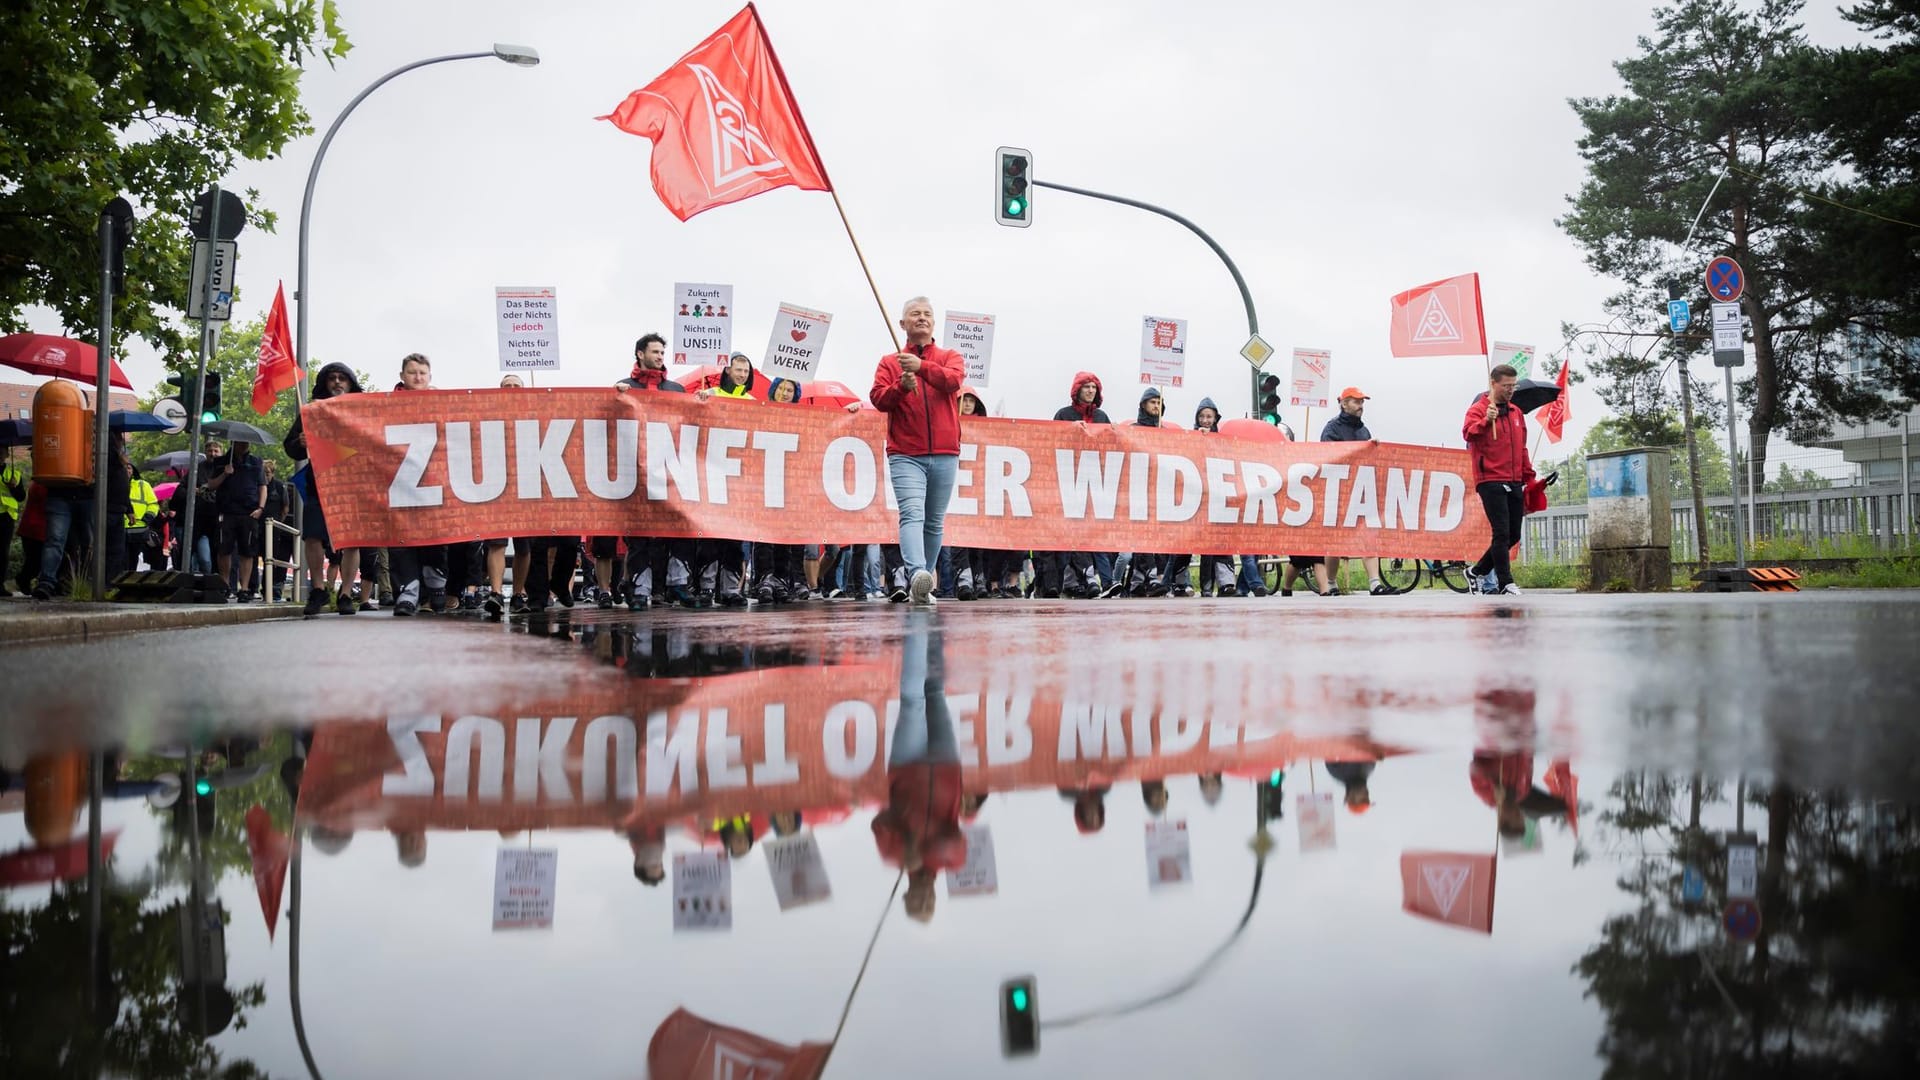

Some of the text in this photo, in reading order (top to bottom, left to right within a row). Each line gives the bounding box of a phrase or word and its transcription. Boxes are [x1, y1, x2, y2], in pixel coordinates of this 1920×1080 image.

[687, 288, 720, 298] Zukunft
[506, 300, 548, 308] Das Beste
[503, 311, 552, 319] oder Nichts
[1671, 303, 1681, 317] P
[512, 322, 544, 332] jedoch
[684, 324, 722, 334] Nicht mit
[792, 319, 812, 331] Wir
[953, 332, 984, 341] brauchst
[508, 338, 550, 348] Nichts für
[683, 338, 722, 350] UNS!!!
[518, 349, 542, 358] beste
[777, 343, 813, 358] unser
[505, 358, 555, 368] Kennzahlen
[773, 355, 810, 372] WERK
[385, 418, 1467, 532] ZUKUNFT OER WIDERSTAND
